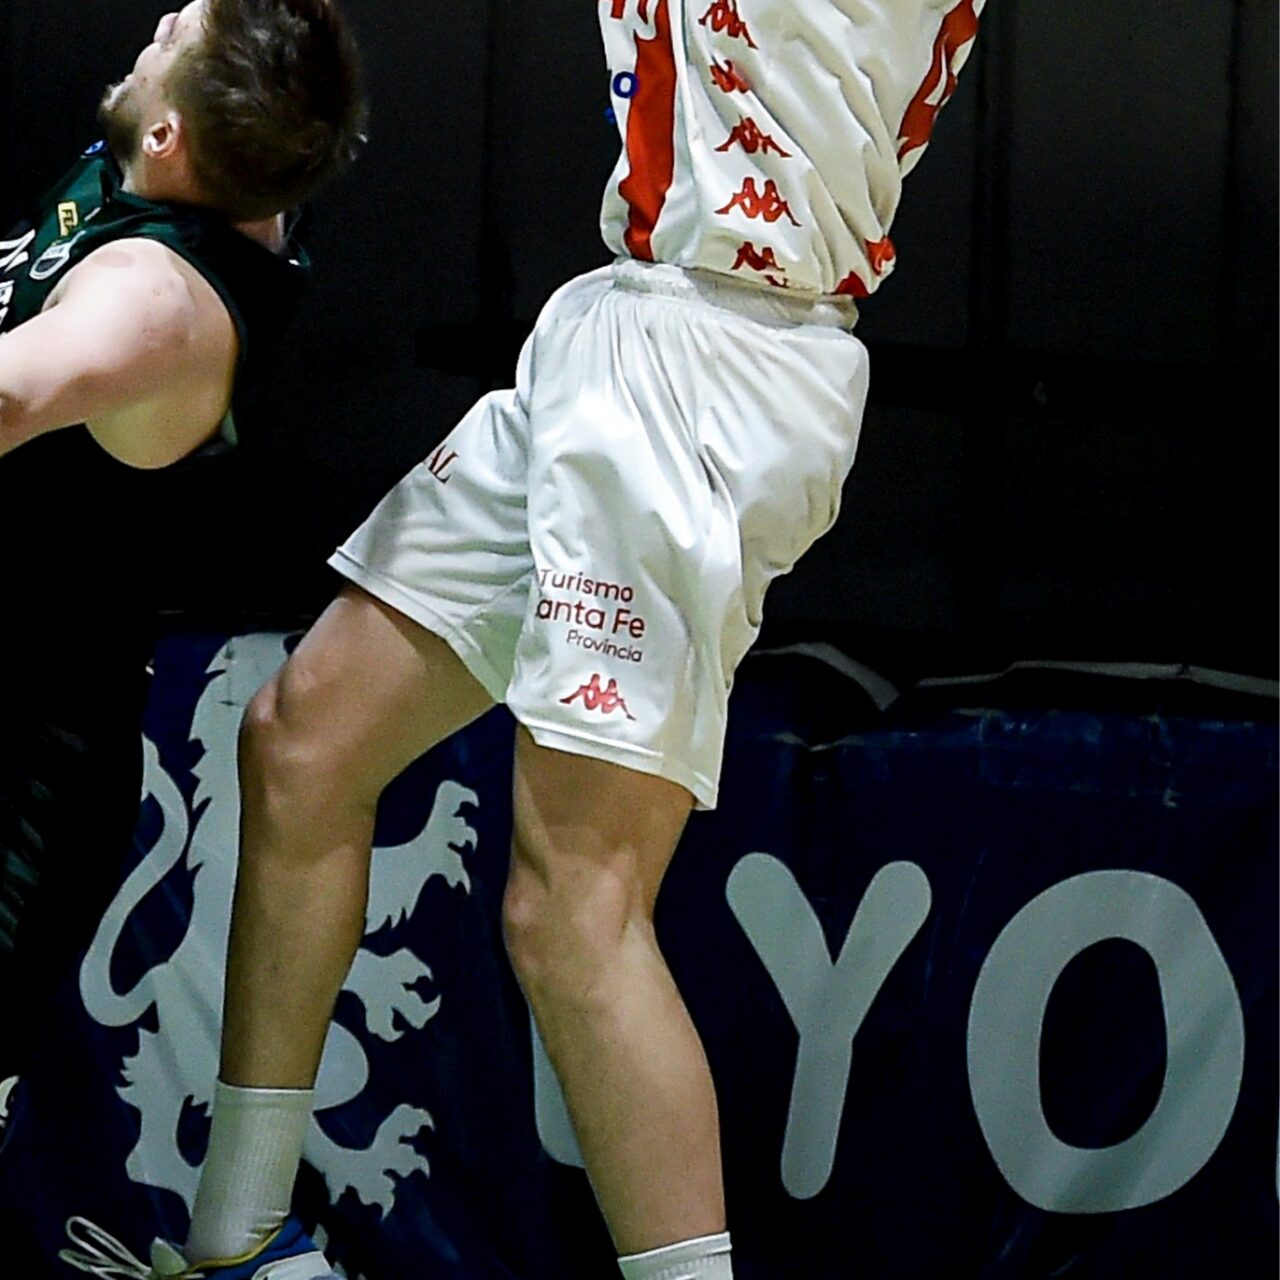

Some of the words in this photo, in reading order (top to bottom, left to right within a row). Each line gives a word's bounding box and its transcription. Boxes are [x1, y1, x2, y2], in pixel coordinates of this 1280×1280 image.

[540, 569, 634, 602] Turismo
[535, 599, 606, 630] anta
[612, 608, 645, 638] Fe
[566, 629, 643, 662] Provincia
[533, 851, 1246, 1215] YO
